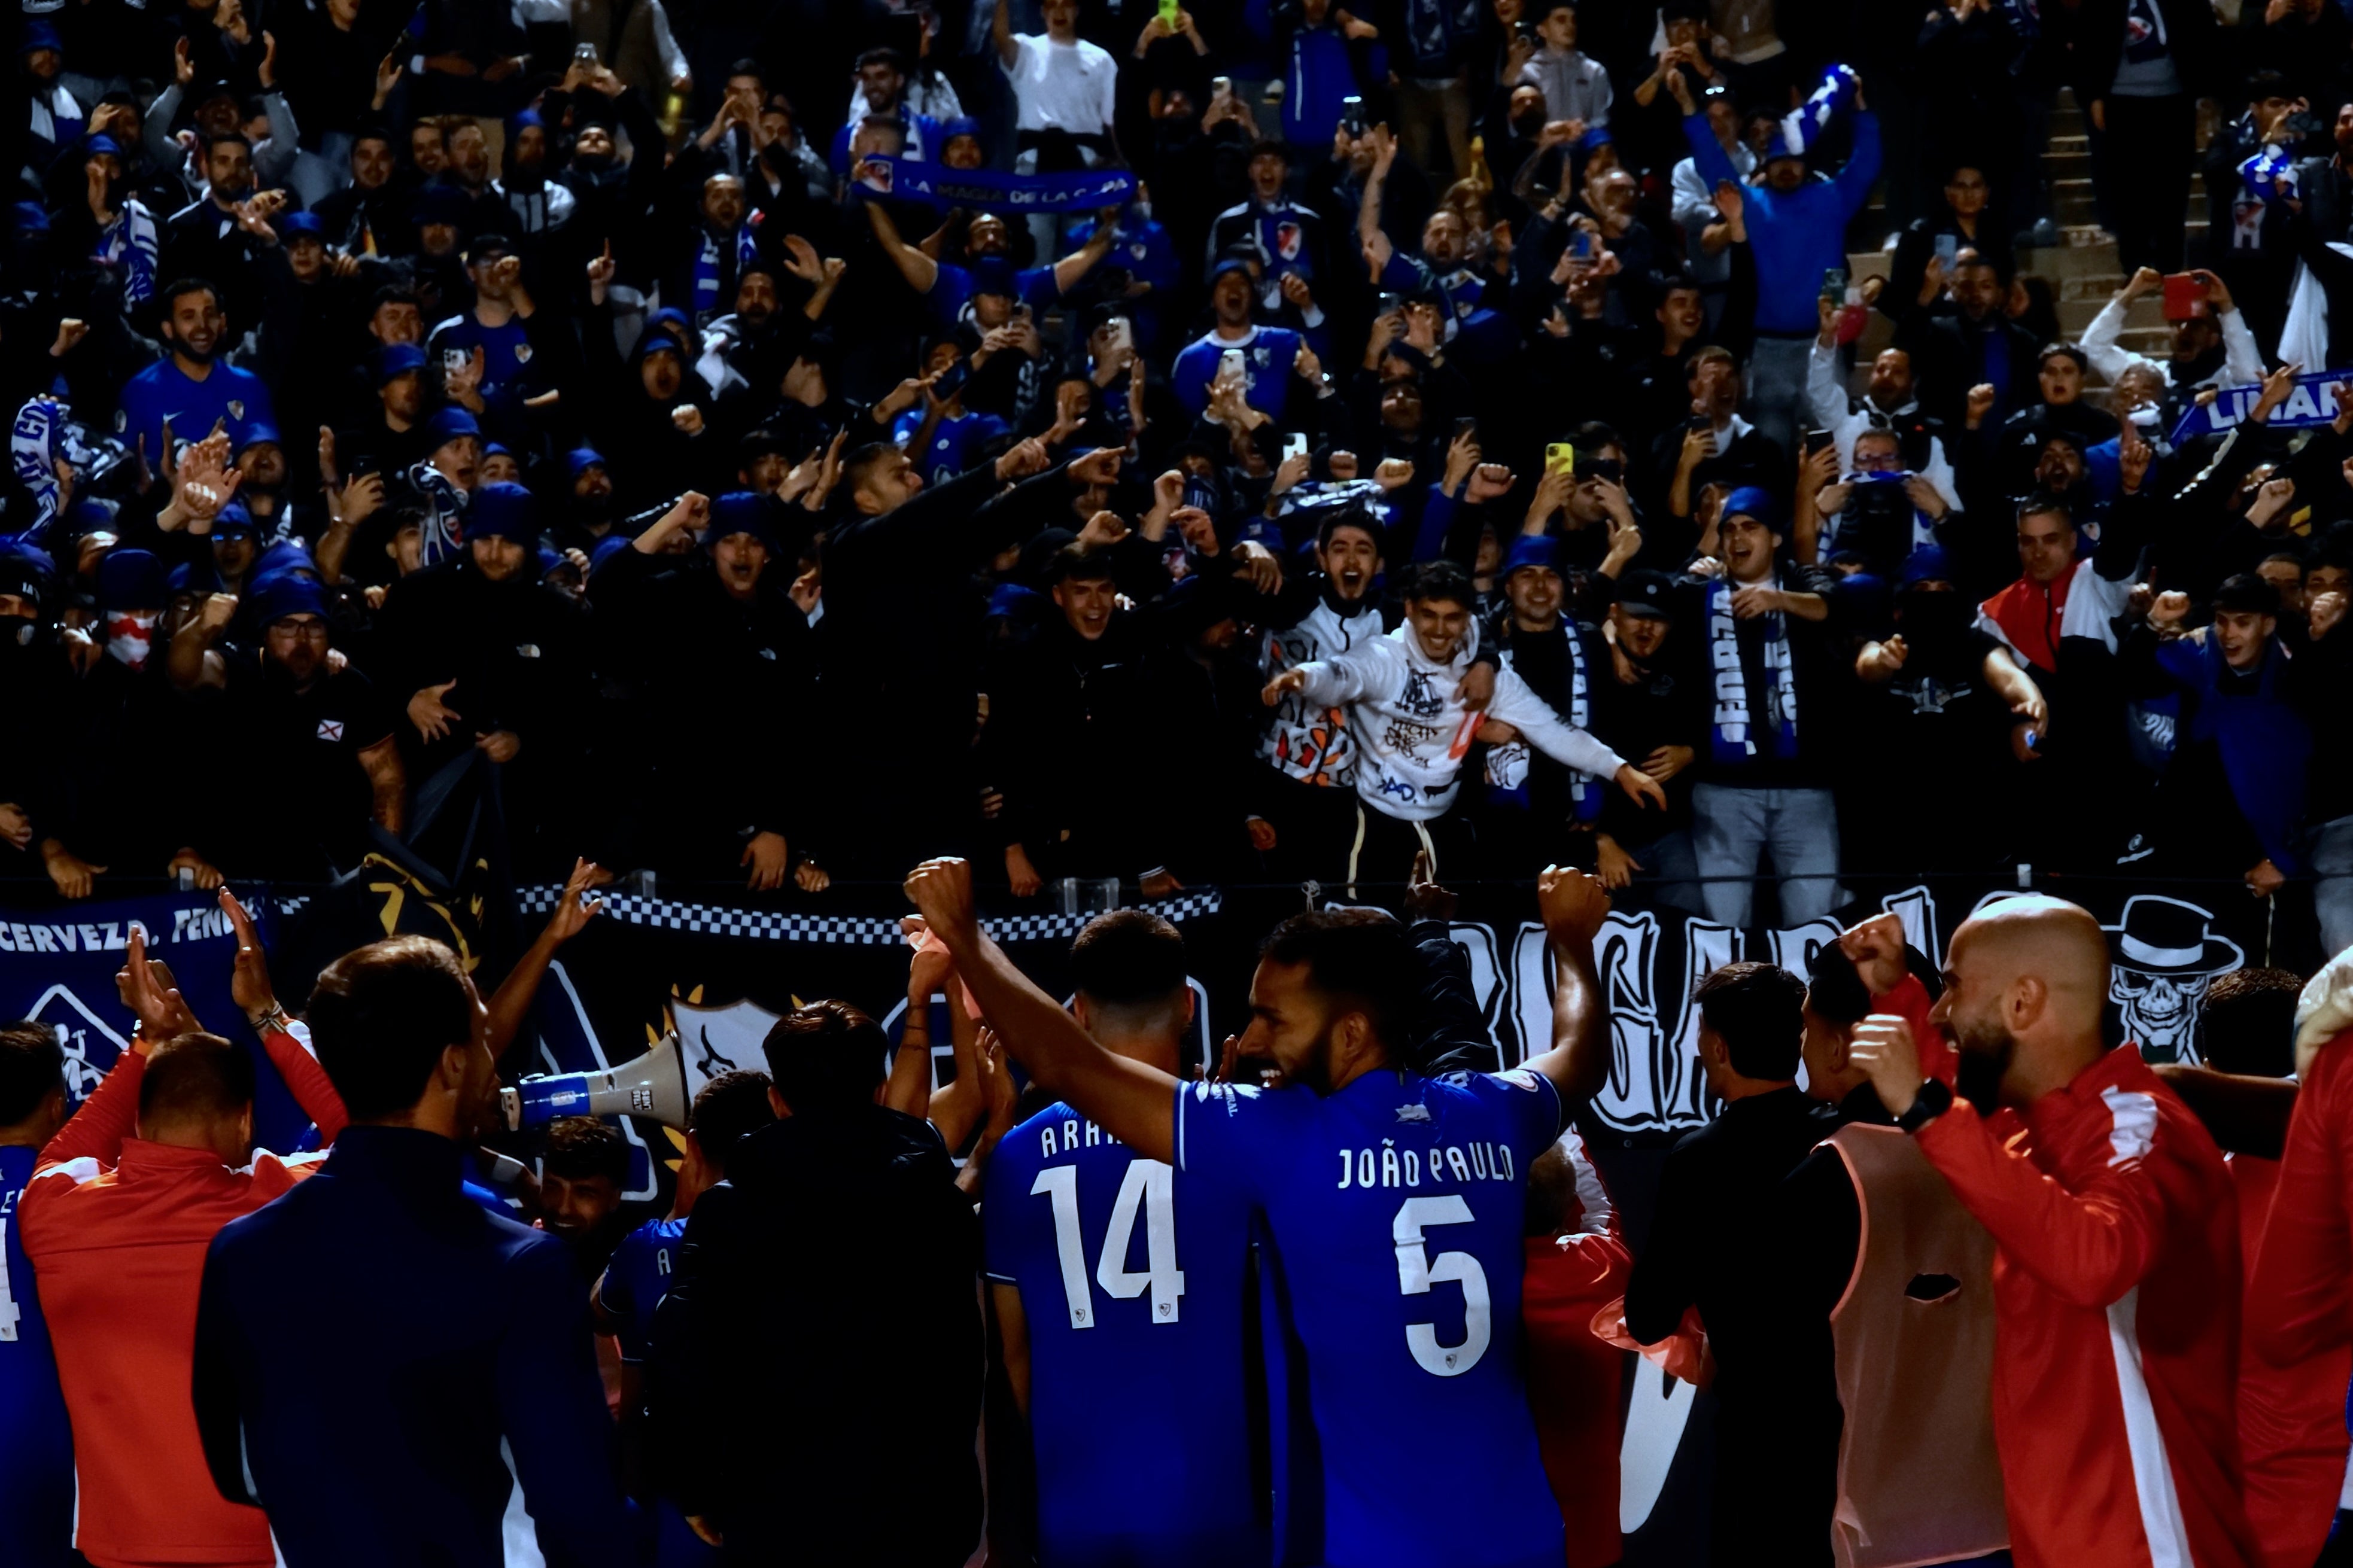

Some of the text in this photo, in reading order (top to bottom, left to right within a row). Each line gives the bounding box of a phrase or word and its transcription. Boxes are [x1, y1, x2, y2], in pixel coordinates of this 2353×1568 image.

[904, 177, 931, 194] LA
[1010, 189, 1036, 205] DE
[1041, 190, 1069, 203] LA
[1073, 177, 1129, 199] CPA
[1337, 1137, 1515, 1189] JOÃO PAULO
[1030, 1159, 1185, 1329] 14
[1393, 1194, 1491, 1377] 5
